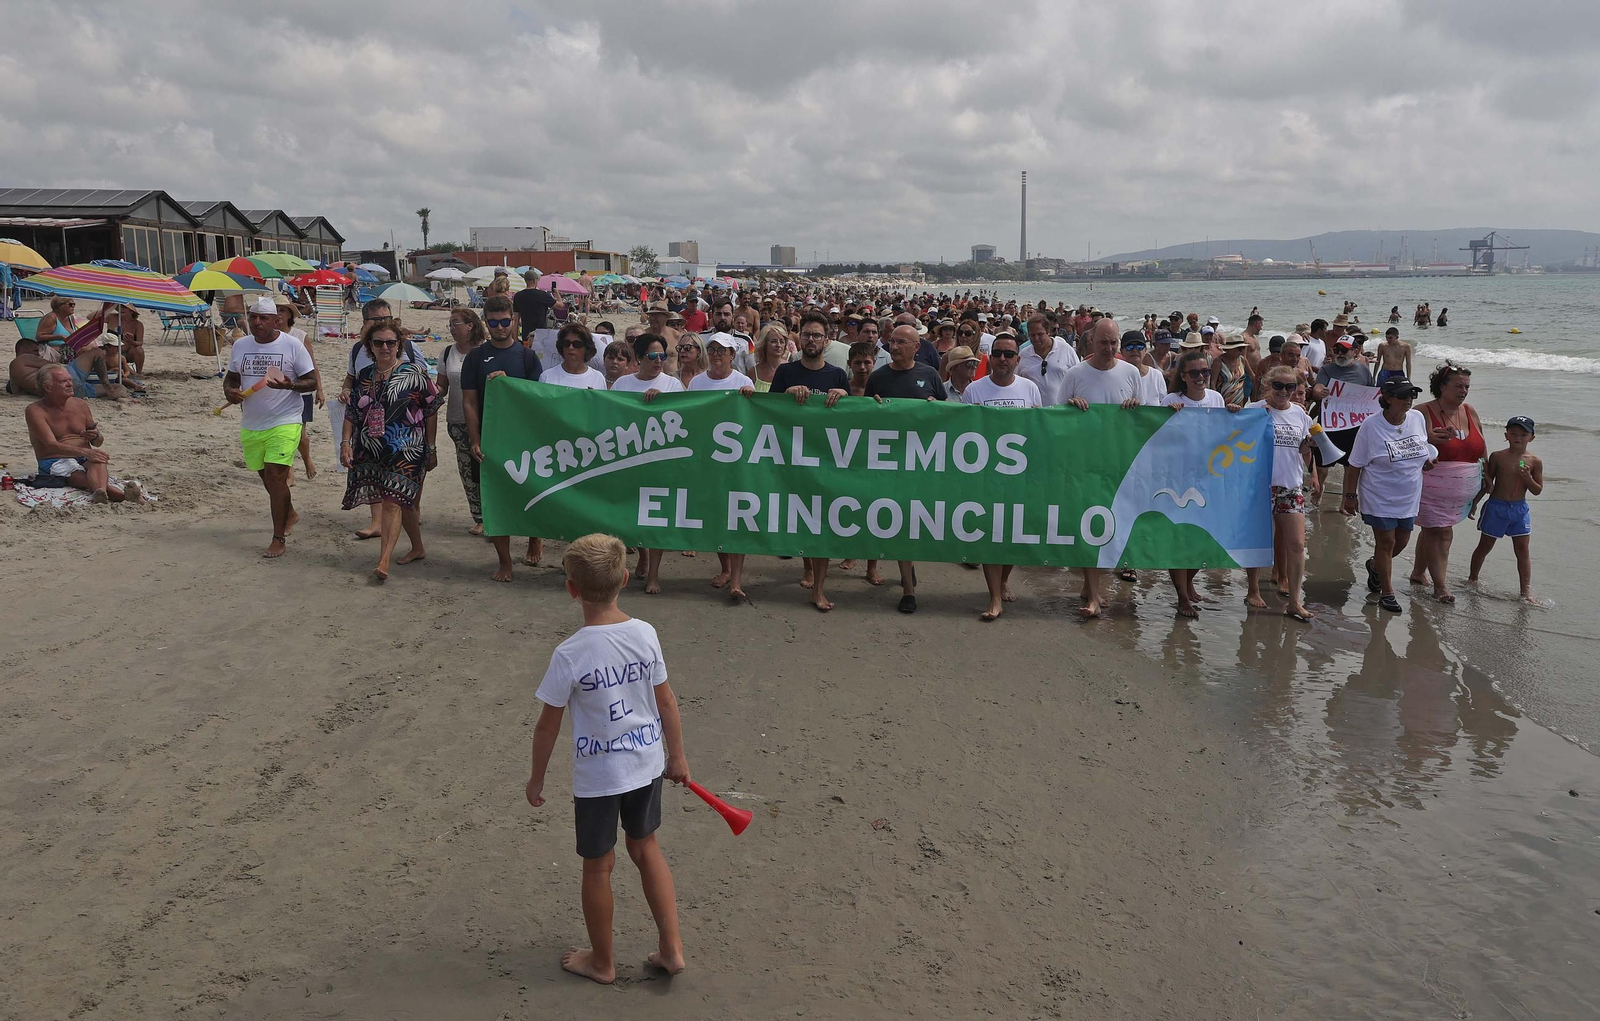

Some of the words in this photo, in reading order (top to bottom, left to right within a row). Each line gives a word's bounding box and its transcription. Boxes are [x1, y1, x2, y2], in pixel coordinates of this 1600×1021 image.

[1324, 412, 1347, 428] LOS
[503, 410, 689, 485] VERDEMAR
[710, 421, 1029, 476] SALVEMOS
[637, 486, 704, 530] EL
[727, 490, 1116, 547] RINCONCILLO
[579, 660, 655, 692] SALVEM
[608, 698, 634, 722] EL
